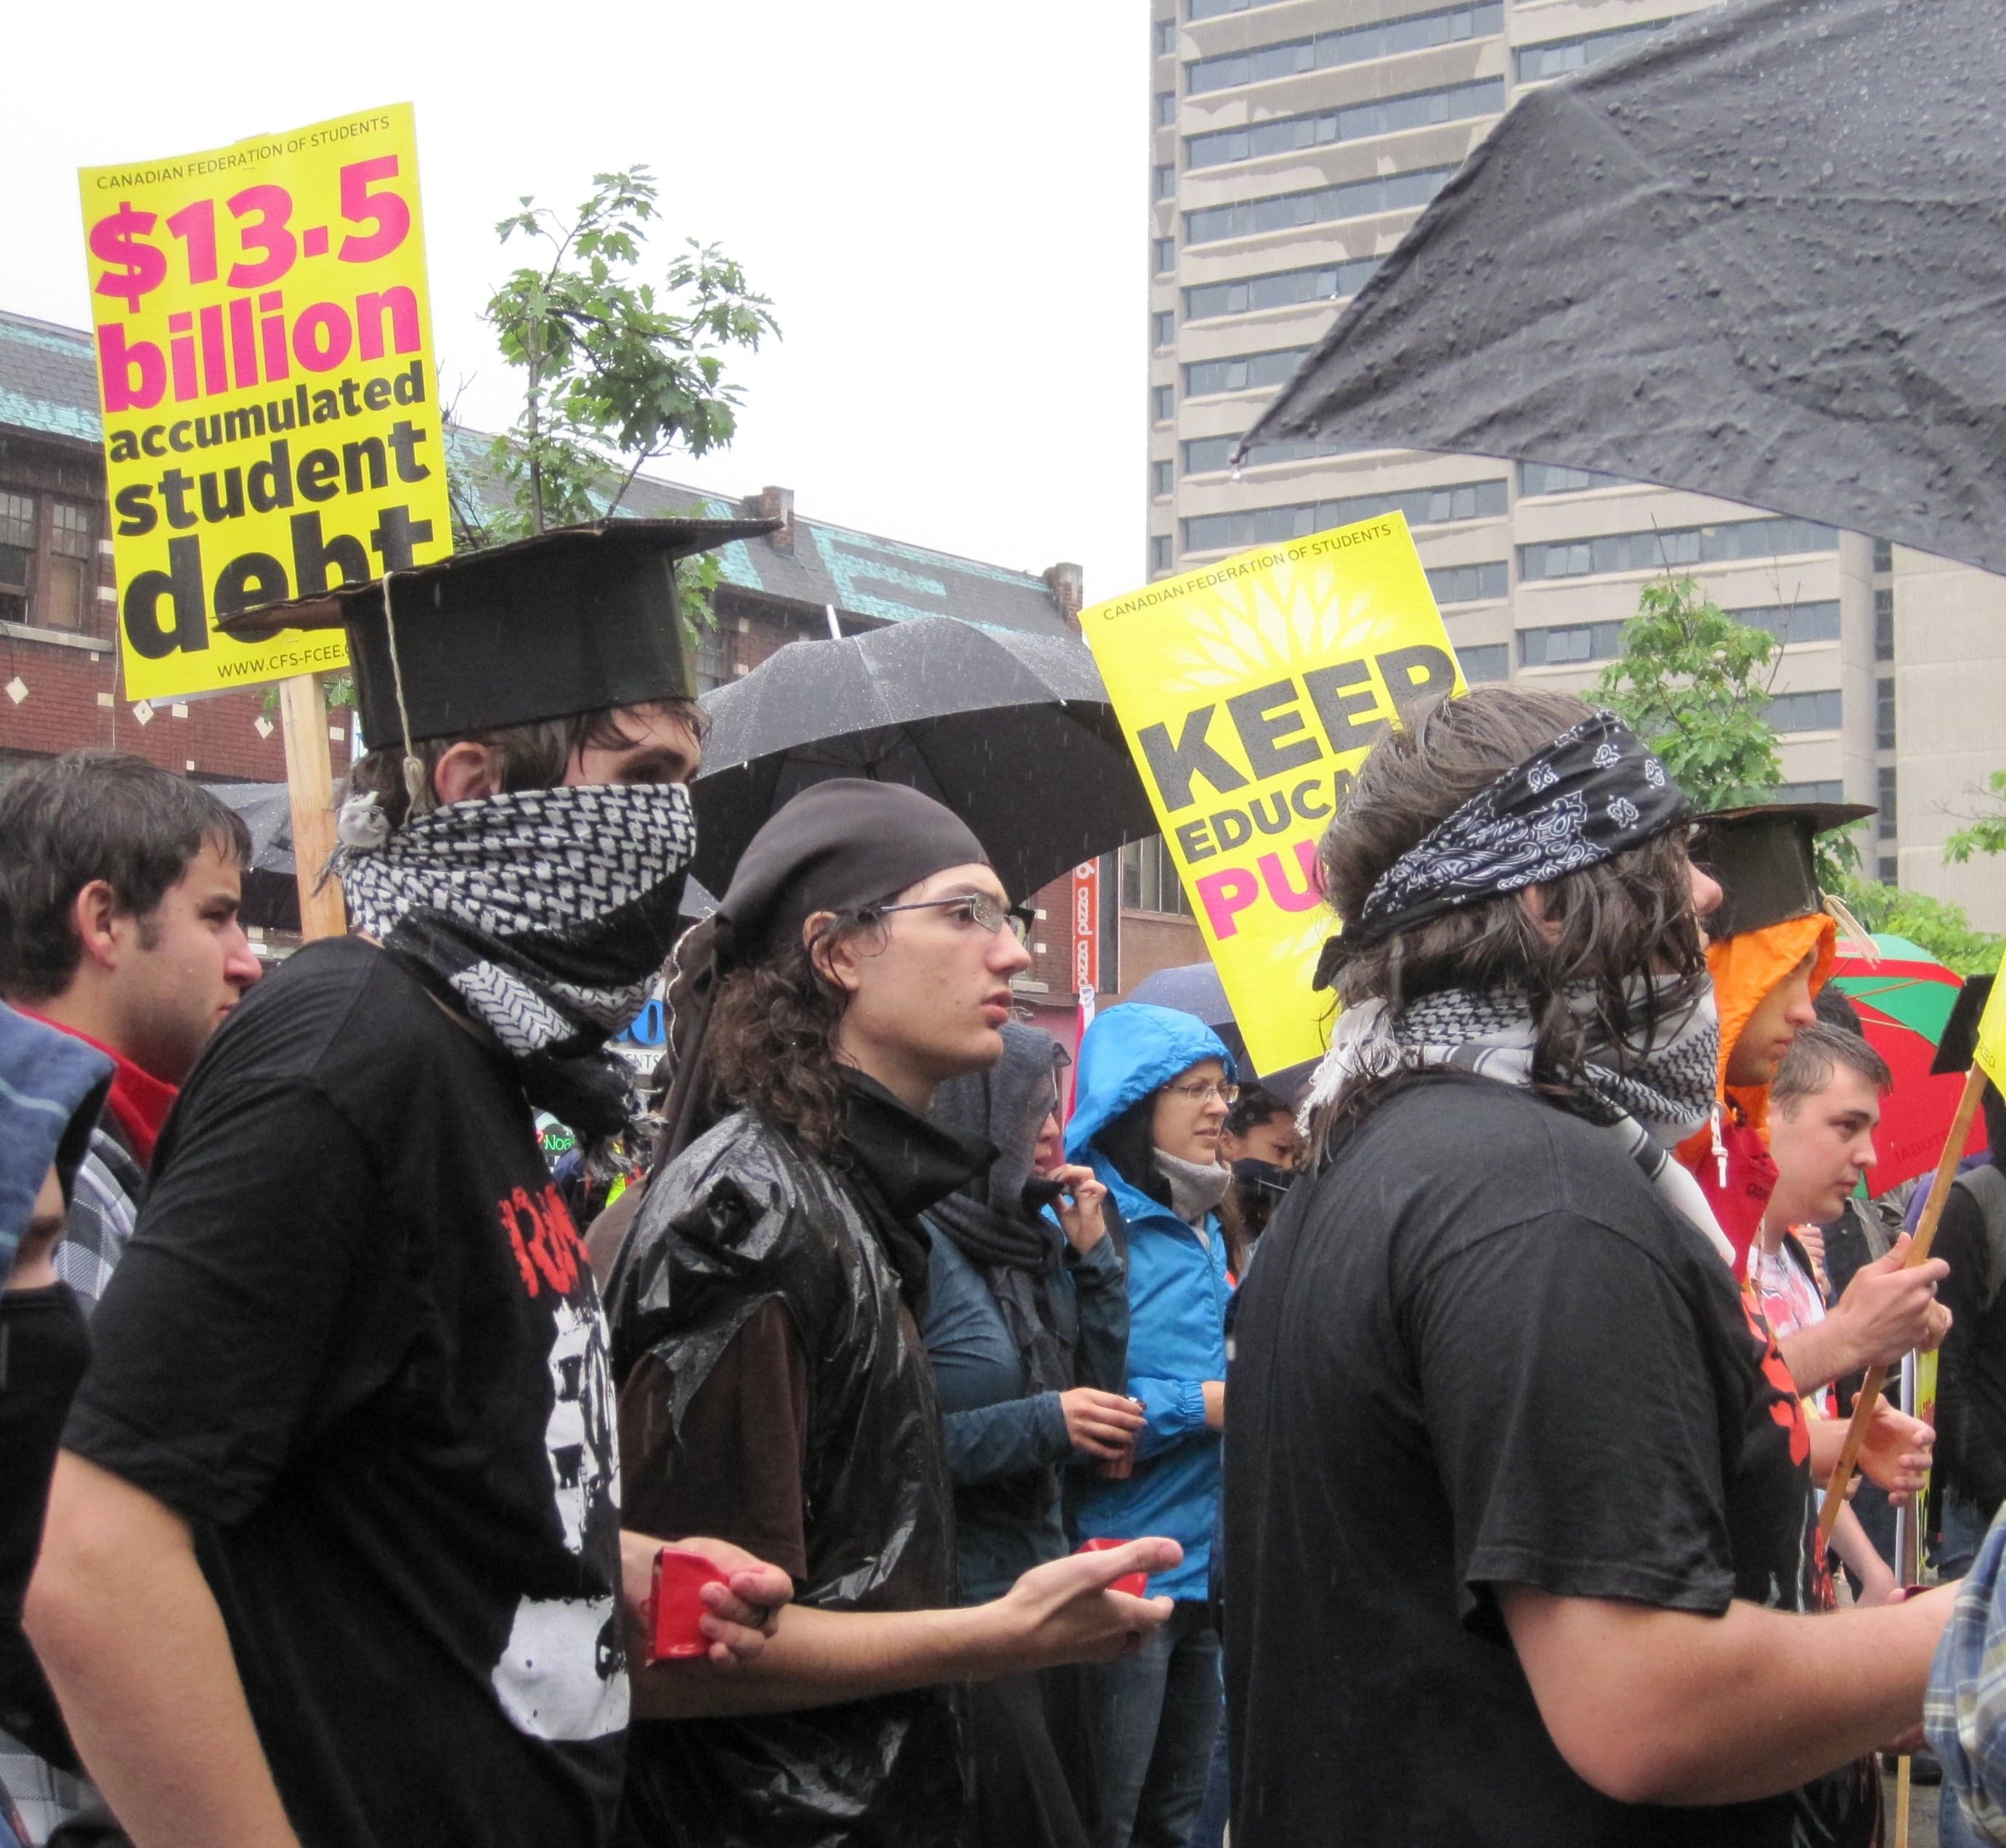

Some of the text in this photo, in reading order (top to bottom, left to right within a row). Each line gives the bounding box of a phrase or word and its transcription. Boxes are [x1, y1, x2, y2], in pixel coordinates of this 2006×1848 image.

[97, 116, 390, 190] CANADIAN FEDERATION OF STUDENTS
[89, 154, 411, 314] $13.5
[98, 285, 421, 413] billion
[109, 359, 426, 463] accumulated
[115, 420, 431, 537] student
[1103, 523, 1392, 621] CANADIAN FEDERATION OF STUDENTS
[217, 644, 349, 678] WWW.CFS-FCEE.
[1077, 886, 1093, 935] pizza
